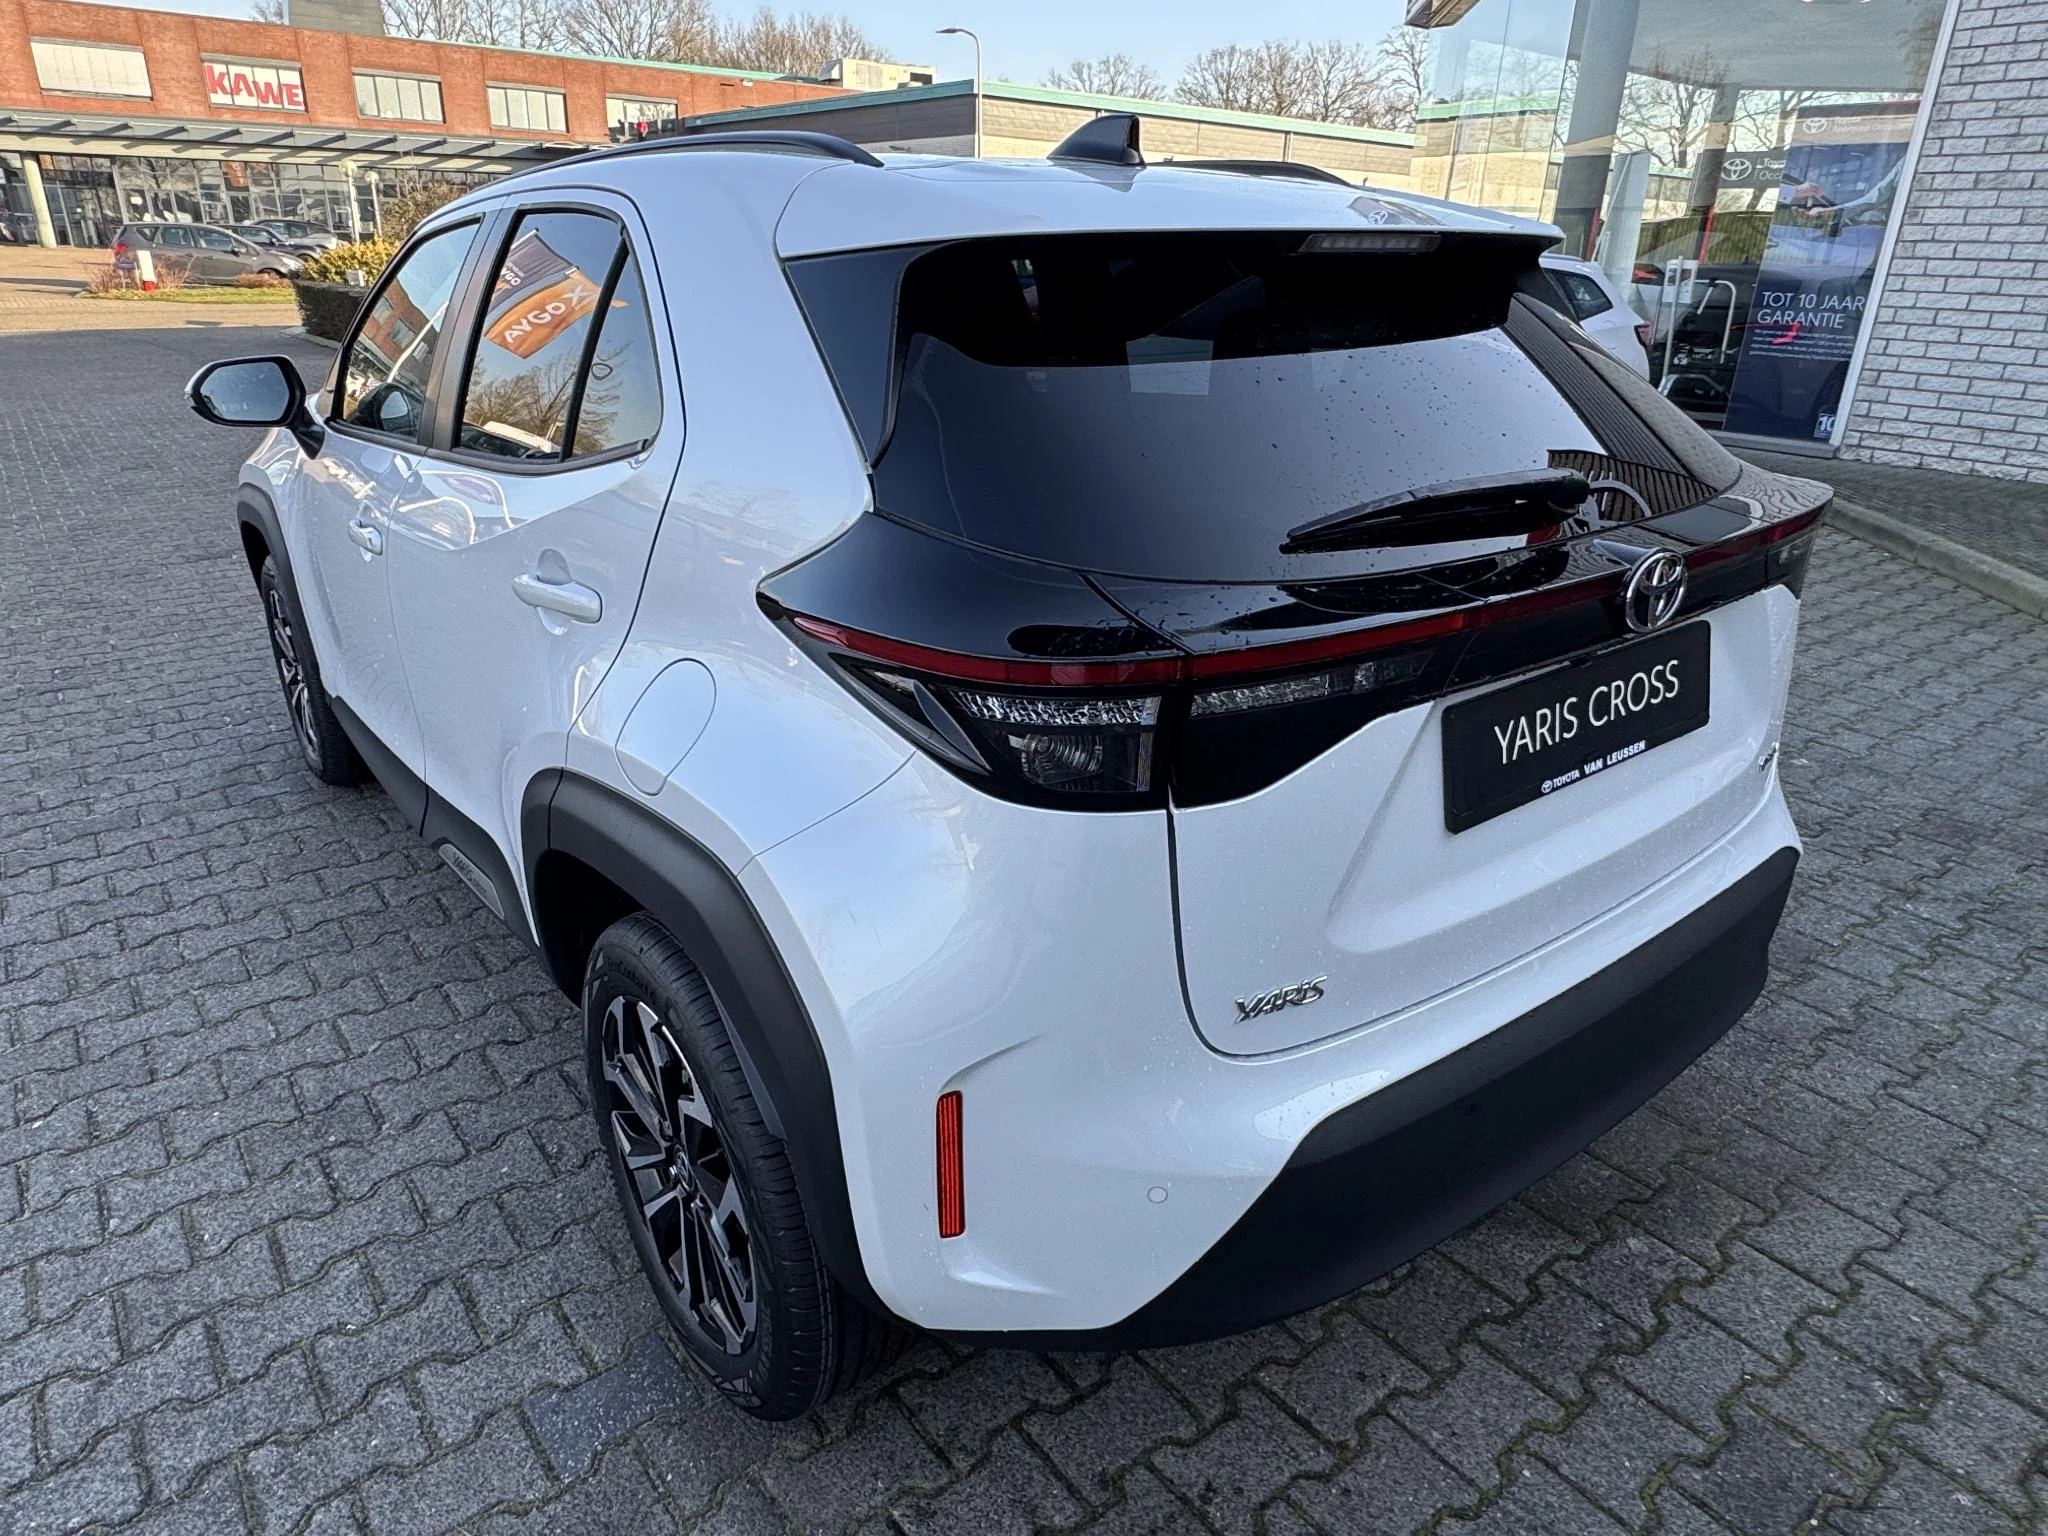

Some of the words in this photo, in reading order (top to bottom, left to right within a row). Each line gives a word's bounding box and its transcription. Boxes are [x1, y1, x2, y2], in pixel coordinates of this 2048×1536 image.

[206, 65, 304, 107] KAWE
[500, 267, 522, 287] YGO
[503, 301, 567, 344] AYGO
[1757, 309, 1846, 330] GARANTIE
[1762, 291, 1795, 308] TOT
[1798, 293, 1817, 309] 10
[1819, 294, 1865, 312] JAAR
[1494, 696, 1579, 765] YARIS
[1588, 659, 1680, 728] CROSS
[1552, 768, 1581, 788] TOYOTA
[1583, 757, 1604, 775] VAN
[1606, 739, 1647, 765] LEUSSEN
[1234, 975, 1329, 1024] YARIS
